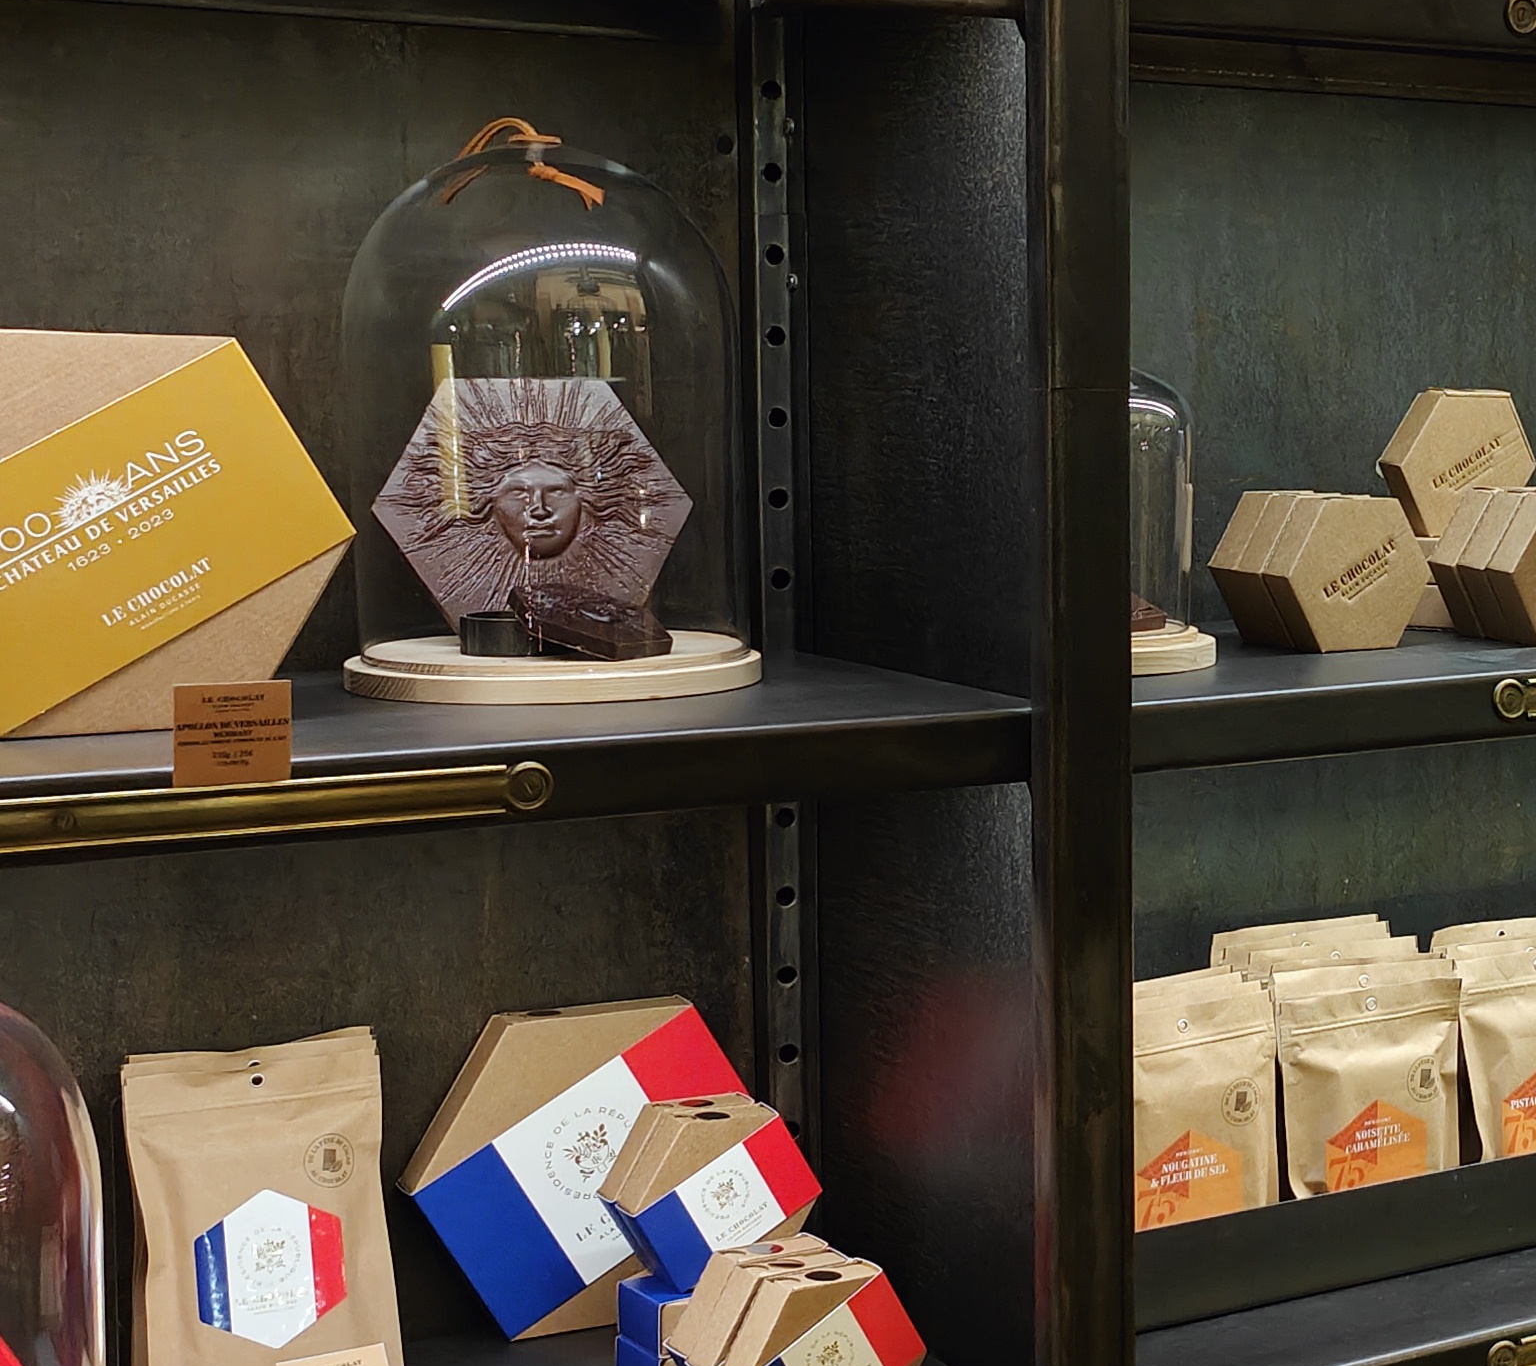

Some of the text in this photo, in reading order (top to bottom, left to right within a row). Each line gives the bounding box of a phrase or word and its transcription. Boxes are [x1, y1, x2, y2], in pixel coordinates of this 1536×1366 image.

[126, 430, 205, 489] ANS
[1431, 435, 1503, 490] LE CHOCOLAT
[85, 517, 114, 540] DE
[115, 458, 222, 523] VERSAILLES
[67, 508, 175, 571] 1623 2023
[1322, 538, 1397, 599] LE CHOCOLAT
[101, 606, 127, 627] LE
[127, 557, 212, 612] CHOCOLAT
[159, 582, 201, 609] DUCASSE
[553, 1107, 592, 1135] DE LA
[1355, 1123, 1401, 1140] NOISETTE
[1345, 1130, 1411, 1155] CARAMÉLISÉE
[1160, 1170, 1192, 1186] FLEUR
[1193, 1167, 1207, 1179] DE
[1208, 1164, 1228, 1176] SEL
[1161, 1154, 1218, 1174] NOUGATINE
[575, 1223, 597, 1242] LE
[716, 1201, 768, 1242] LE CHOCOLAT
